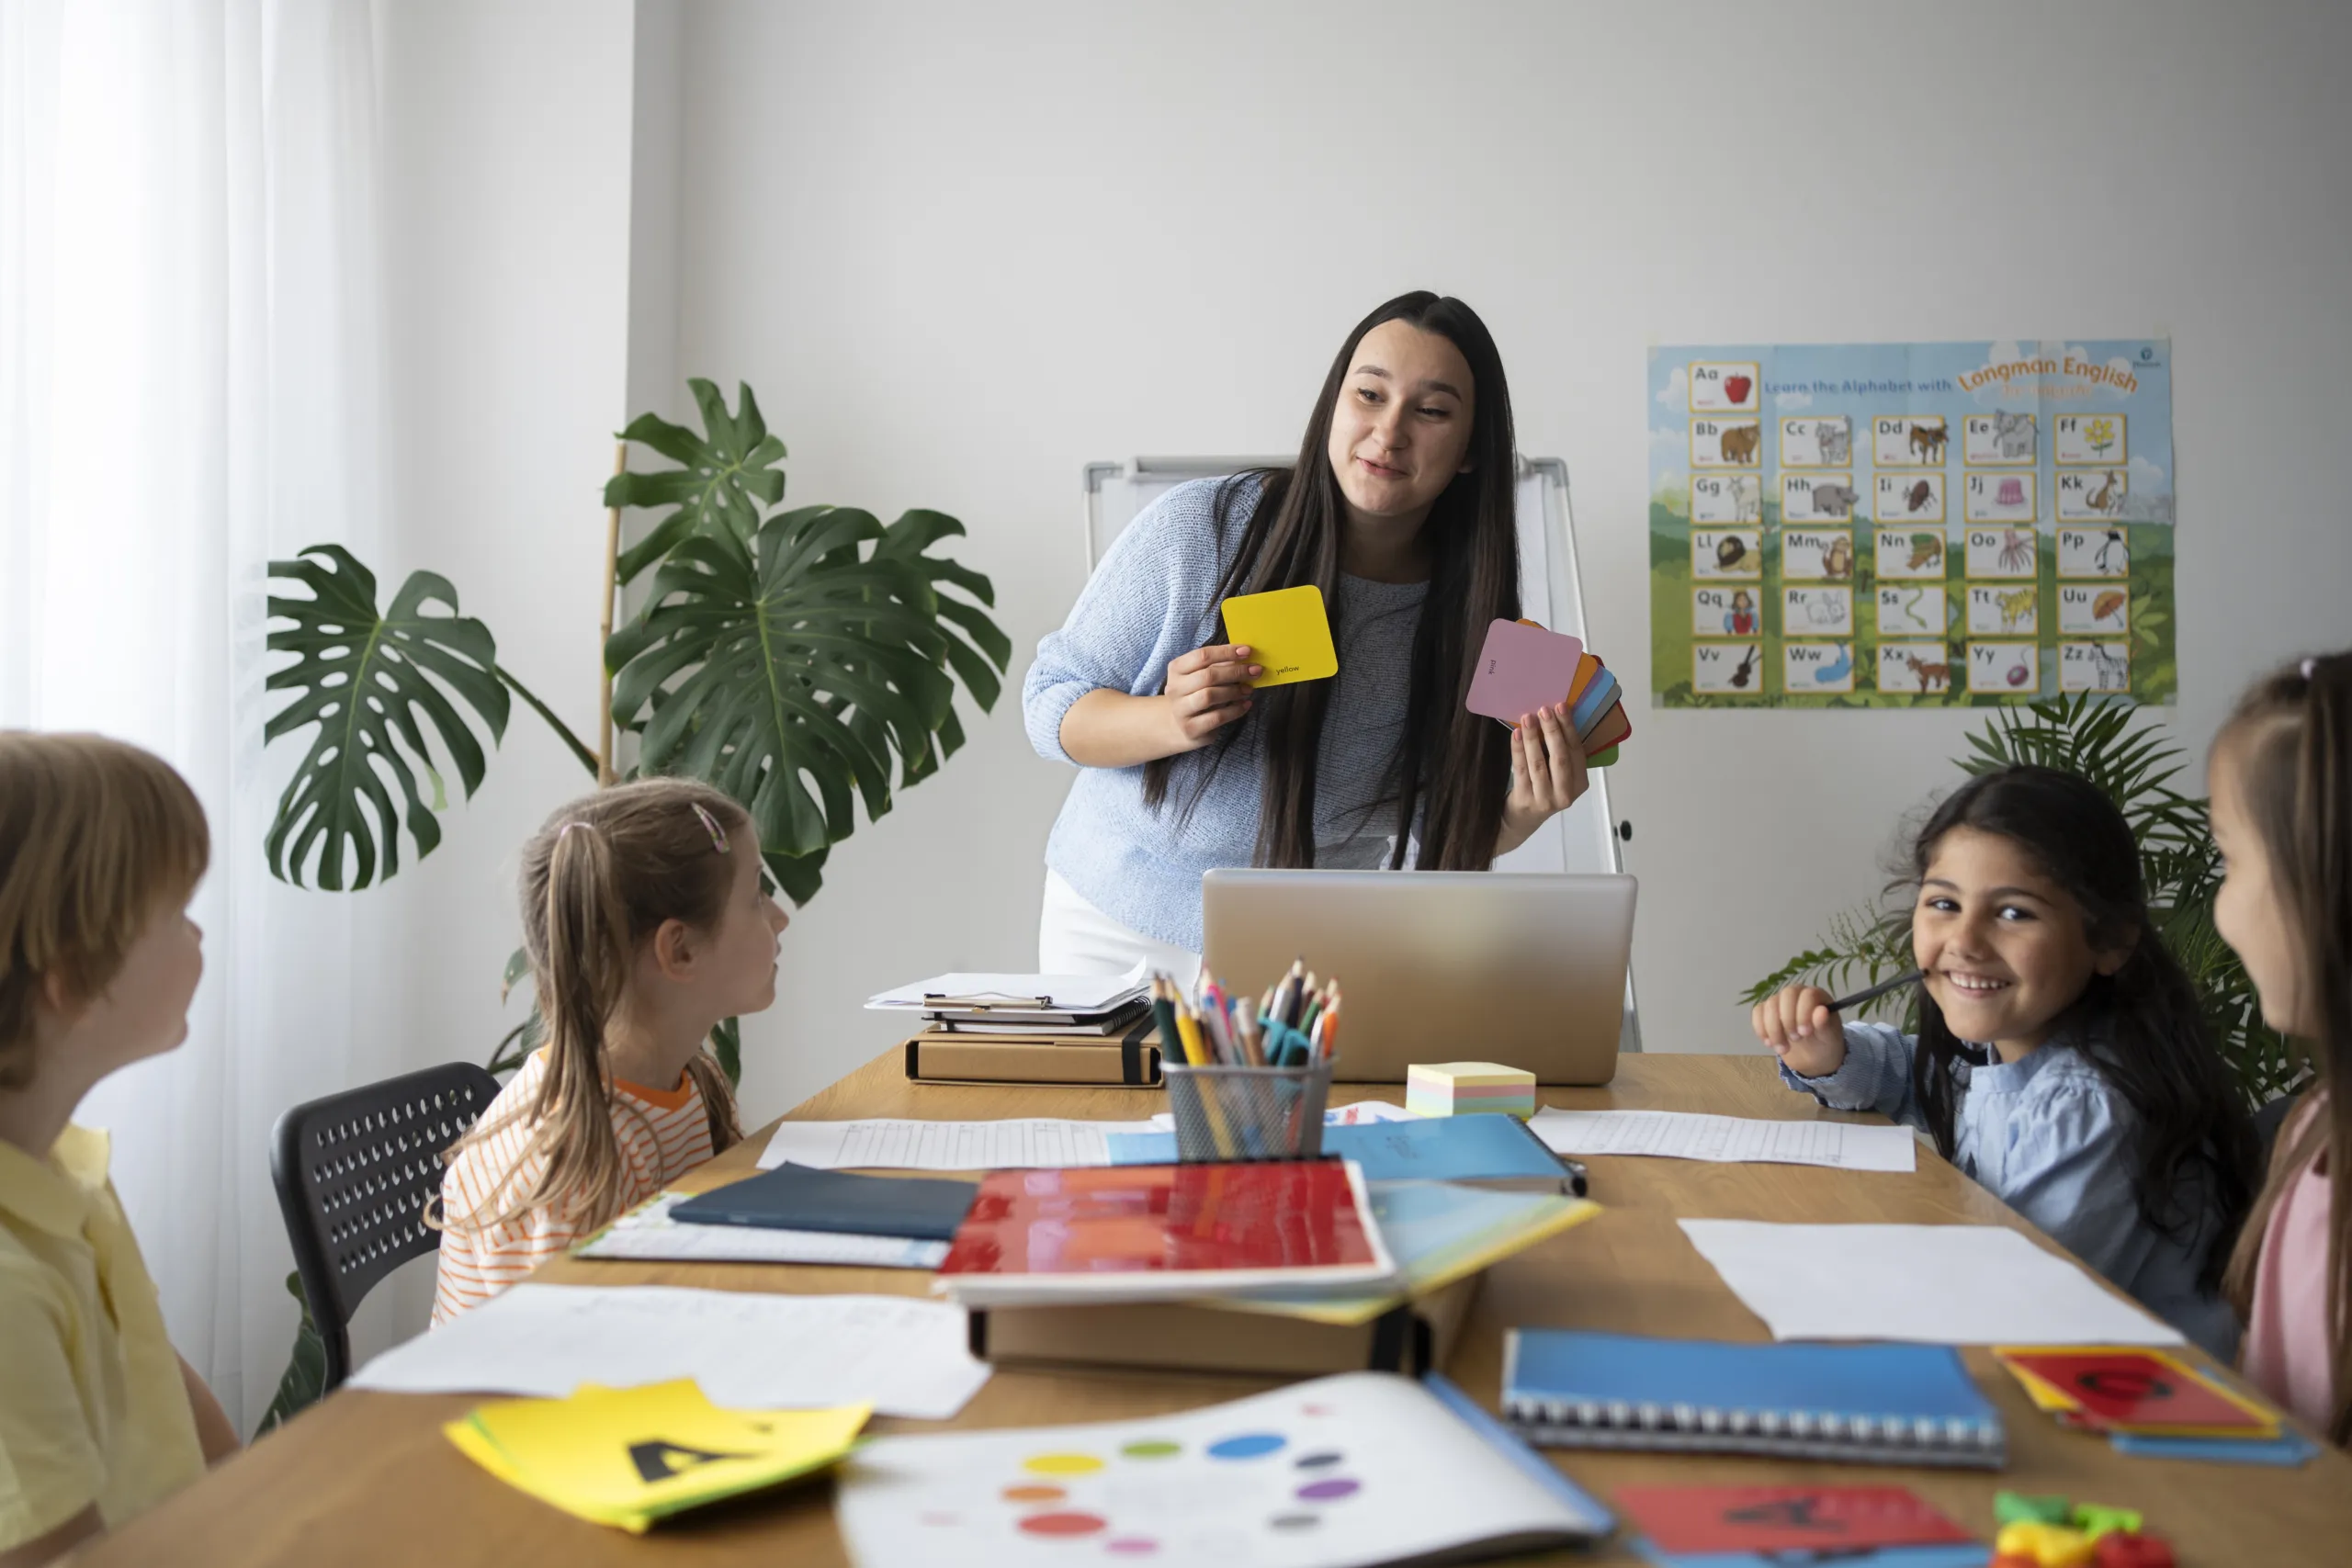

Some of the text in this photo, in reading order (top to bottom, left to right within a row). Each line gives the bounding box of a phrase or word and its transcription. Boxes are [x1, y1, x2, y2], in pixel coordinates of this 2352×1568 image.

[1695, 367, 1719, 380] Aa
[1957, 356, 2139, 392] Longman English
[1764, 378, 1952, 396] Learn the Alphabet with
[1696, 422, 1718, 435] Bb
[1785, 421, 1806, 435] Cc
[1880, 420, 1903, 434] Dd
[1970, 420, 1988, 433] Ee
[2061, 418, 2076, 432] Ff
[1697, 479, 1720, 497] Gg
[1788, 479, 1810, 491] Hh
[1881, 479, 1891, 491] Ii
[1970, 477, 1983, 494] Jj
[2062, 476, 2082, 489] Kk
[1698, 535, 1712, 548] Ll
[1789, 535, 1818, 547] Mm
[1882, 534, 1904, 547] Nn
[1972, 533, 1996, 547] Oo
[2064, 533, 2084, 548] Pp
[1698, 592, 1723, 607] Qq
[1789, 591, 1806, 604] Rr
[1882, 588, 1898, 604] Ss
[1973, 590, 1989, 603] Tt
[2064, 590, 2086, 603] Uu
[1699, 649, 1719, 660] Vv
[1790, 649, 1821, 660] Ww
[1884, 649, 1903, 660] Xx
[1974, 648, 1994, 663] Yy
[2064, 647, 2082, 660] Zz
[1276, 666, 1300, 675] yellow
[1488, 660, 1497, 675] pink
